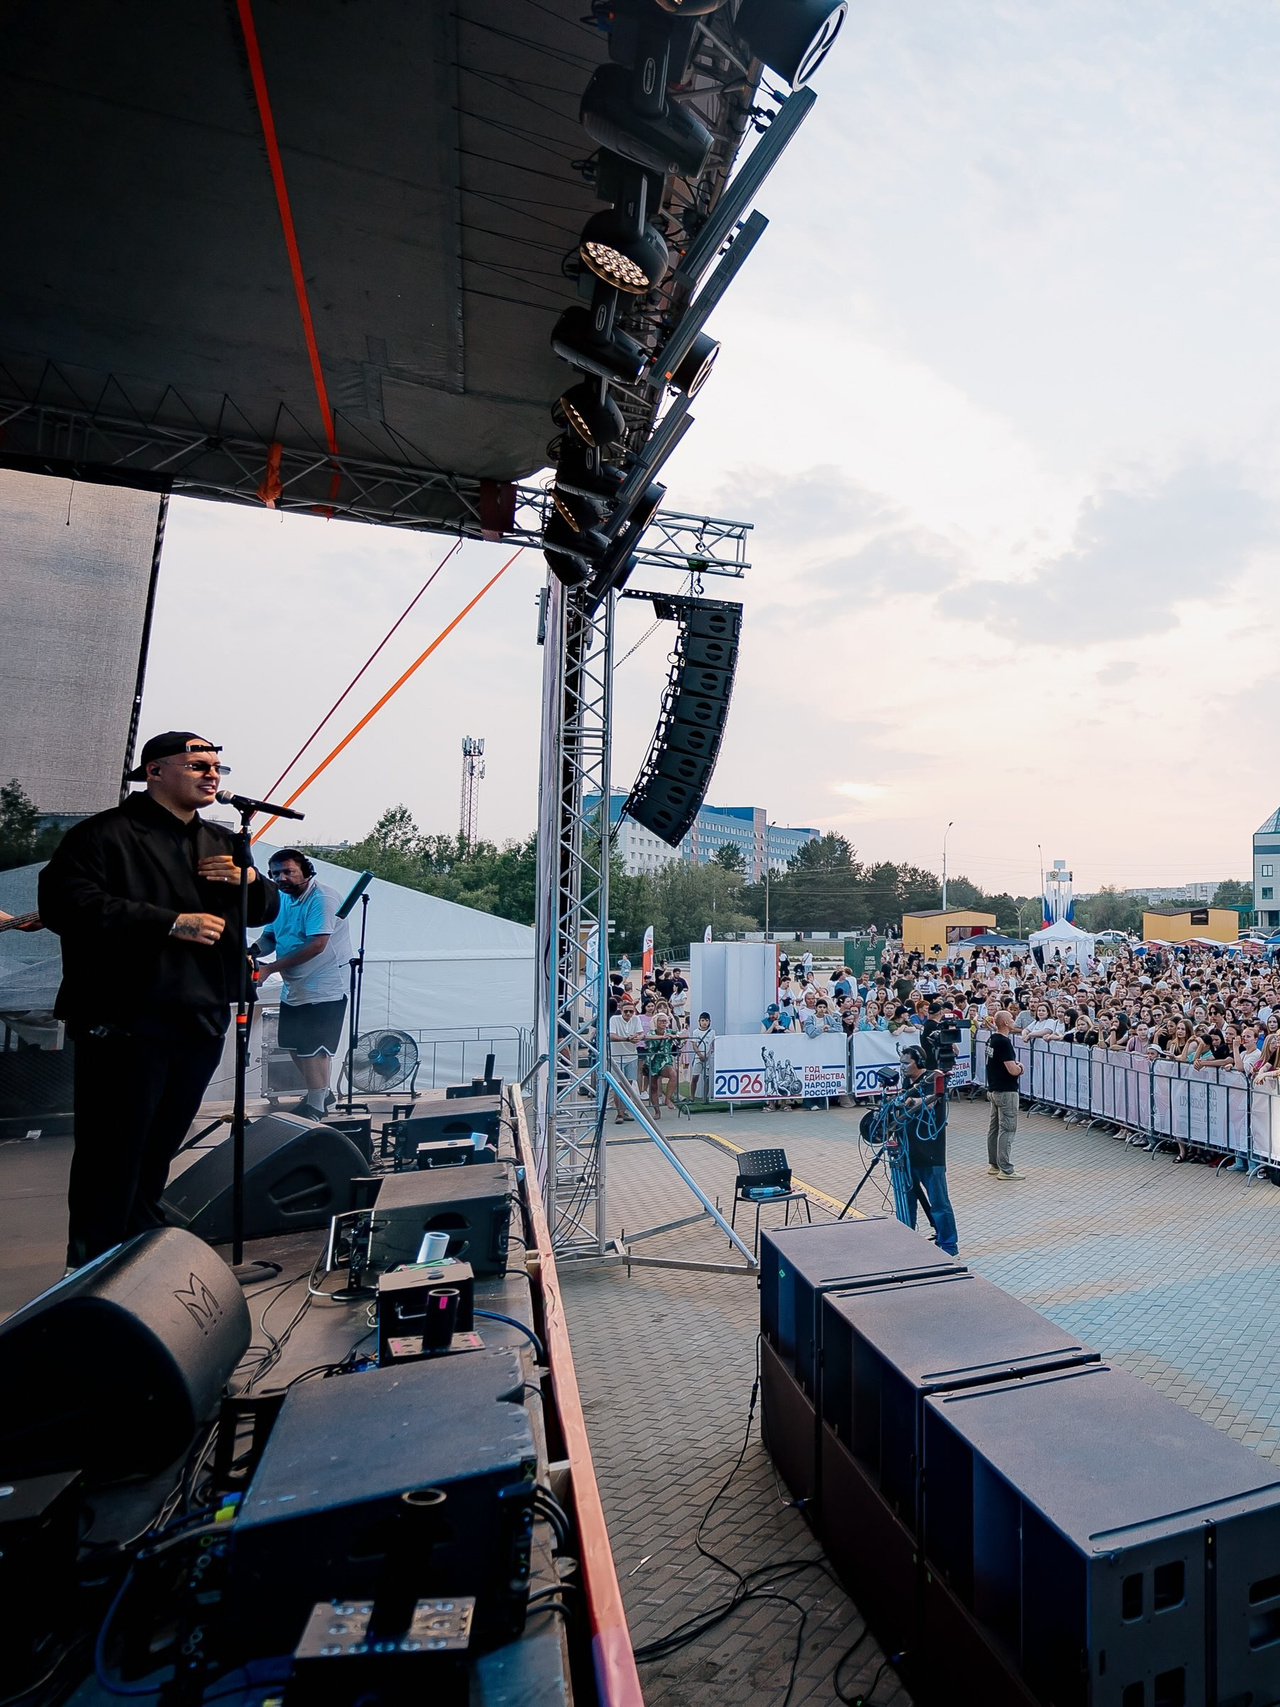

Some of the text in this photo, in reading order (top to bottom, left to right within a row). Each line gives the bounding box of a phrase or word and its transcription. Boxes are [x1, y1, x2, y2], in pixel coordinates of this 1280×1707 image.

[804, 1065, 820, 1074] ГОД
[804, 1072, 846, 1082] ЕДИНСТВА
[715, 1073, 763, 1096] 2026
[804, 1080, 842, 1090] НАРОДОВ
[804, 1088, 837, 1097] РОССИИ
